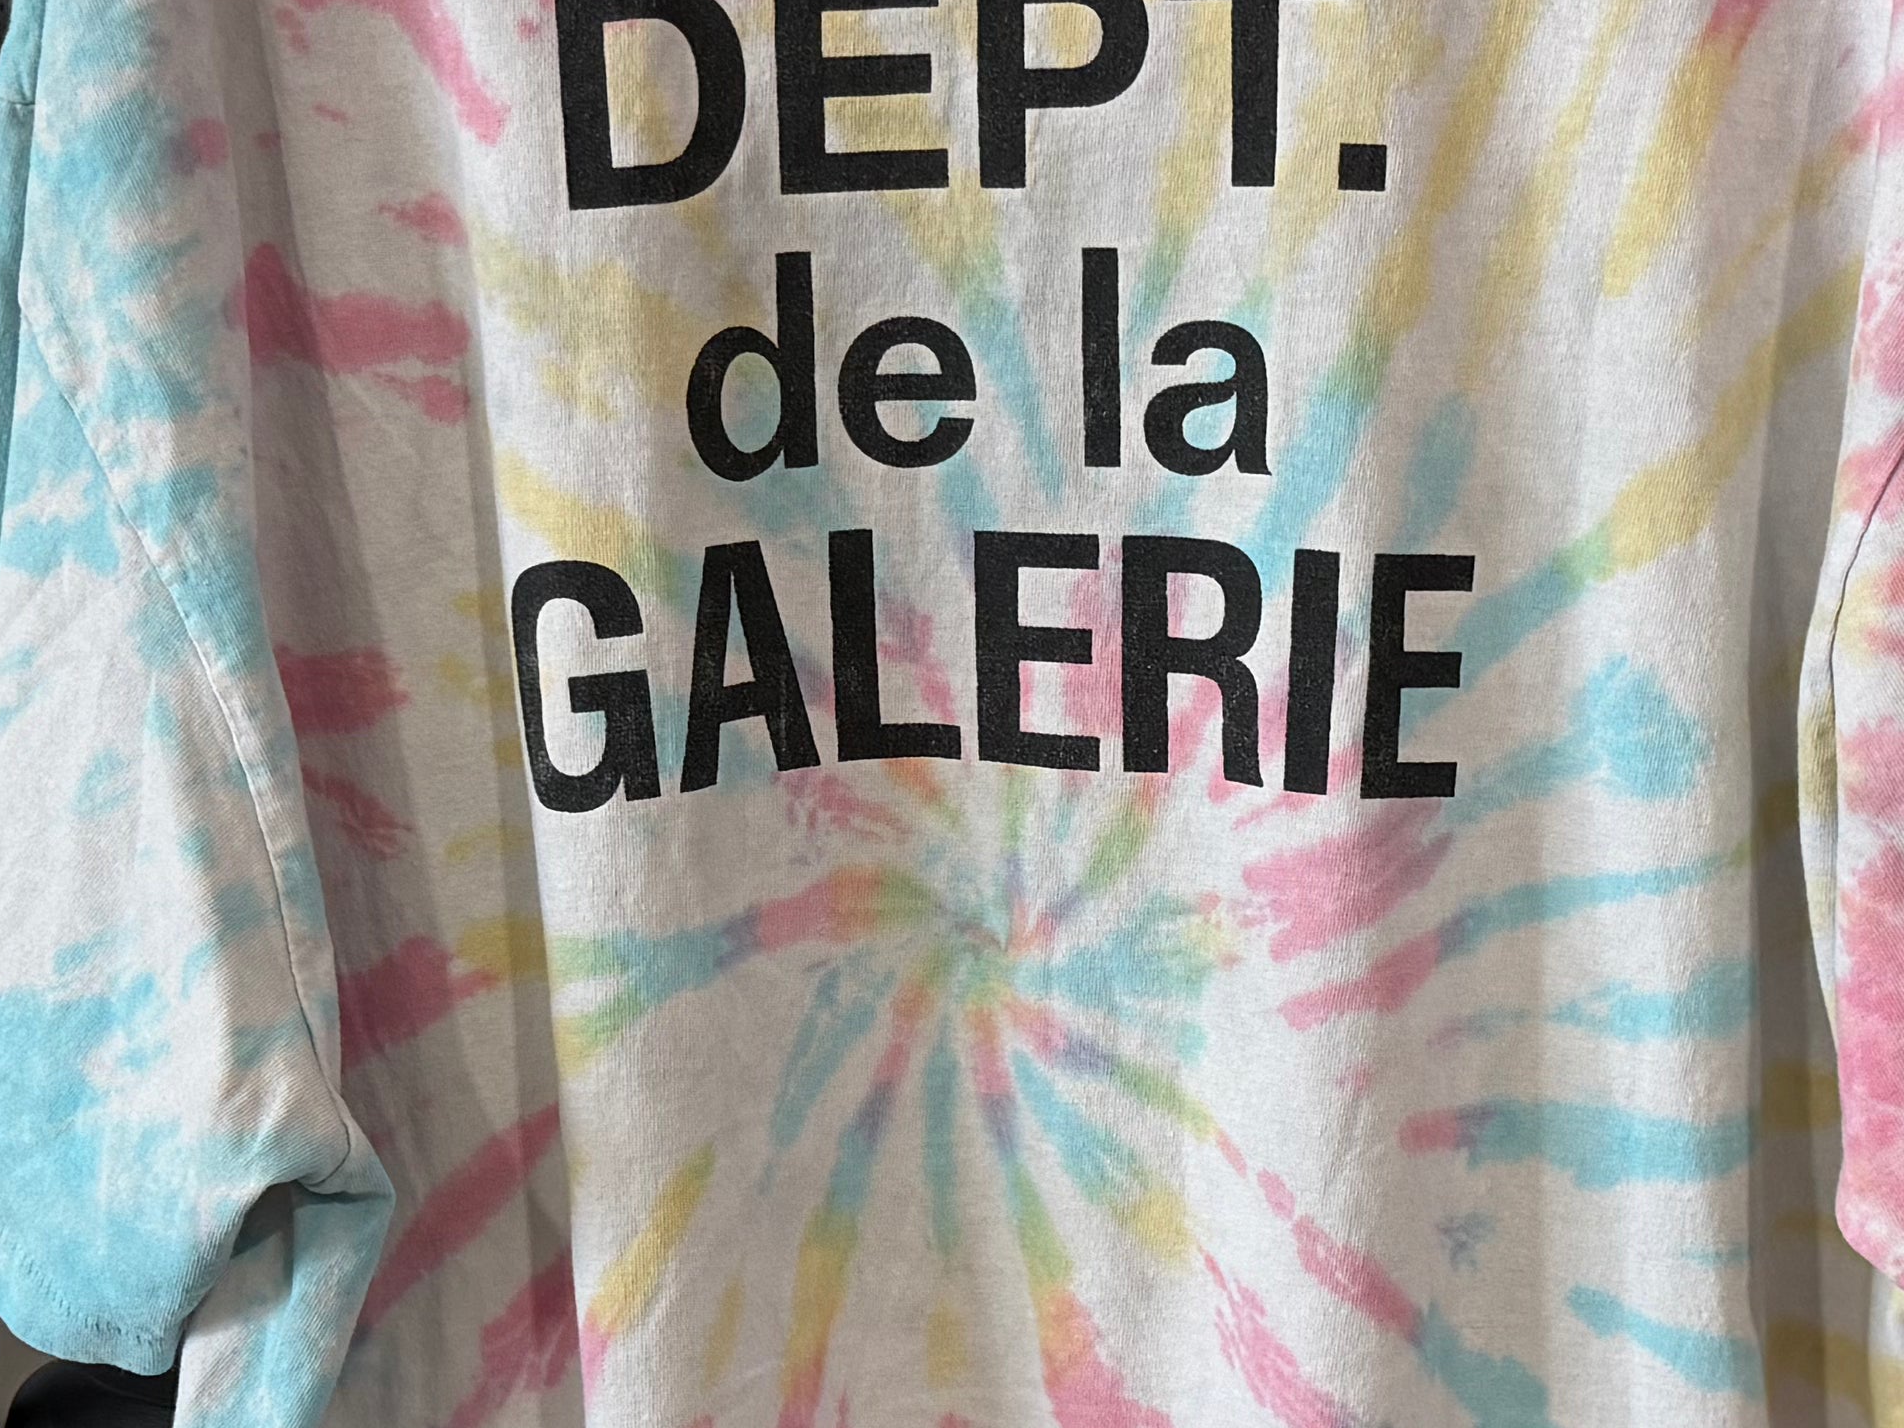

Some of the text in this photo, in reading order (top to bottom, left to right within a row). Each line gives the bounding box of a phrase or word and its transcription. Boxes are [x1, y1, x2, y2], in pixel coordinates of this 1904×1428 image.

[686, 248, 1271, 482] de la
[512, 529, 1475, 813] GALERIE
